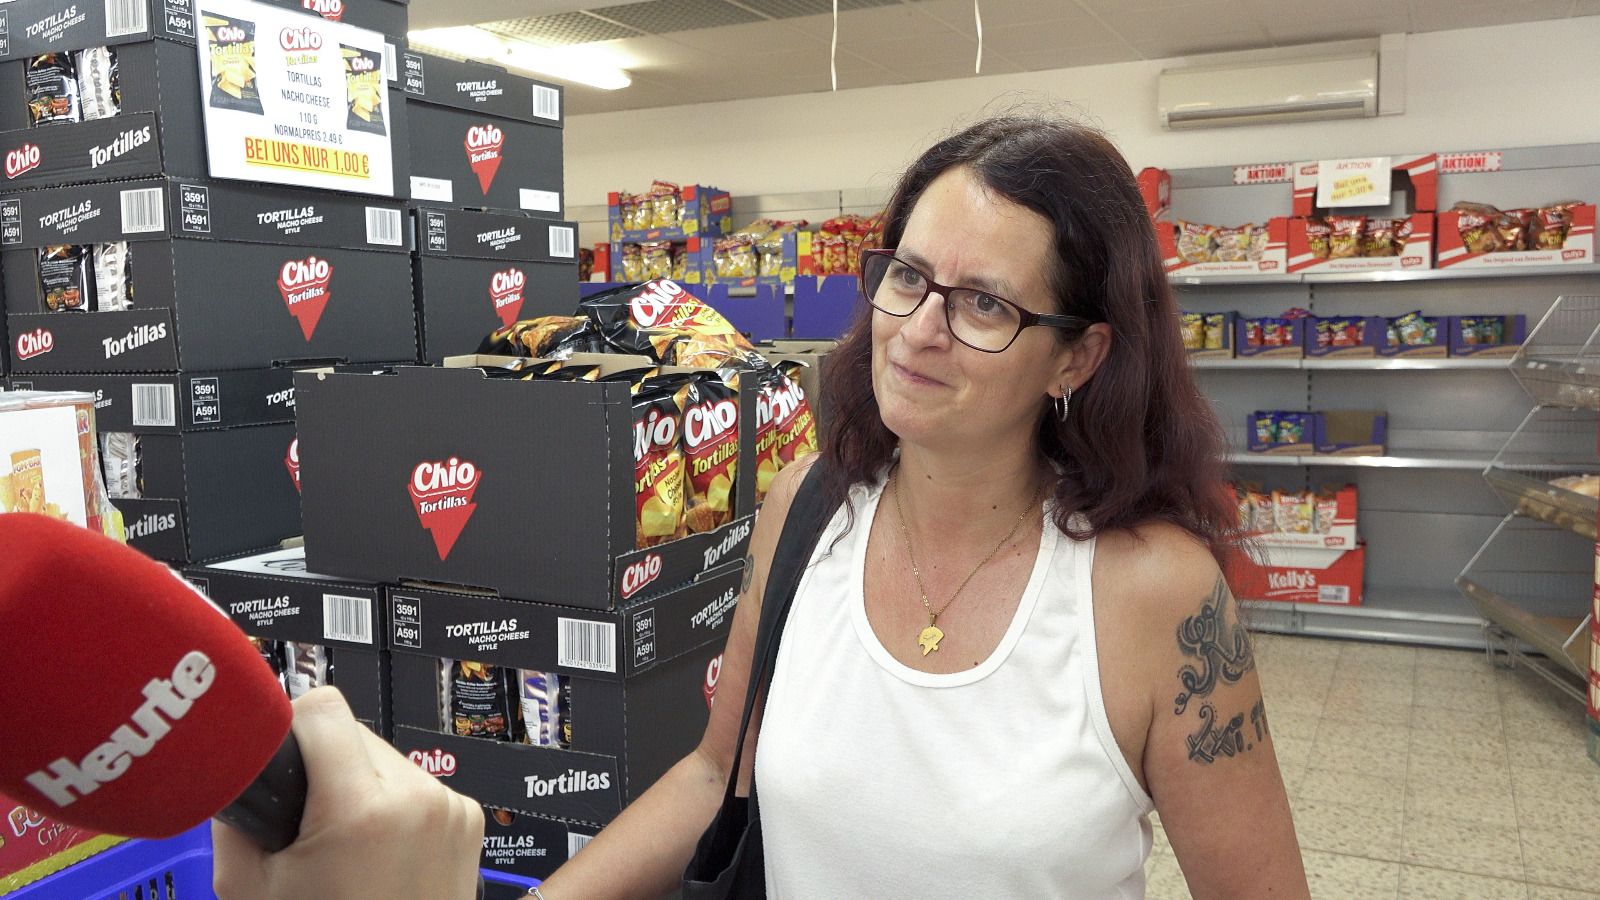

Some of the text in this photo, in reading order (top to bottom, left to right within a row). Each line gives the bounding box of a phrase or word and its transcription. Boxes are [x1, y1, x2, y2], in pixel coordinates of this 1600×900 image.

[26, 5, 77, 38] TORTILLAS
[42, 14, 86, 39] NACHO CHEESE
[169, 17, 192, 30] A591
[49, 32, 63, 43] STYLE
[218, 27, 245, 41] Chio
[280, 27, 322, 51] Chio
[406, 60, 421, 70] 3591
[287, 70, 322, 88] TORTILLAS
[407, 78, 422, 88] A591
[456, 80, 496, 92] TORTILLAS
[281, 89, 331, 109] NACHO CHEESE
[300, 112, 318, 125] 110 G
[274, 124, 322, 142] NORMALPREIS
[338, 134, 343, 144] €
[467, 124, 502, 148] Chio
[6, 125, 151, 174] Chio Tortillas
[245, 137, 370, 175] BEI UNS NUR 1,00 €
[471, 150, 498, 164] Tortillas
[1442, 157, 1487, 169] AKTION!
[1247, 167, 1286, 181] AKTION!
[184, 191, 205, 204] 3591
[2, 205, 18, 217] 3591
[39, 200, 92, 229] TORTILLAS
[56, 208, 101, 231] NACHO CHEESE
[257, 206, 314, 225] TORTILLAS
[185, 214, 207, 226] A591
[277, 215, 323, 230] NACHO CHEESE
[3, 227, 20, 238] A591
[63, 224, 78, 235] STYLE
[285, 227, 300, 235] STYLE
[477, 227, 515, 243] TORTILLAS
[282, 256, 328, 287] Chio
[492, 268, 524, 293] Chio
[287, 285, 325, 305] Tortillas
[495, 292, 520, 309] Tortillas
[632, 279, 682, 327] Chio
[17, 322, 167, 359] Chio Tortillas
[194, 384, 215, 395] 3591
[195, 405, 217, 417] A591
[685, 400, 737, 448] Chio
[776, 411, 812, 450] Tortillas
[692, 440, 738, 477] Tortillas
[414, 457, 475, 492] Chio
[420, 496, 467, 515] Tortillas
[124, 513, 175, 542] ortillas
[622, 521, 750, 593] Chio Tortillas
[1268, 570, 1316, 589] Kelly's
[230, 596, 290, 616] TORTILLAS
[249, 607, 300, 620] NACHO CHEESE
[396, 604, 417, 617] 3591
[691, 587, 734, 629] TORTILLAS
[256, 618, 274, 627] STYLE
[636, 617, 652, 632] 3591
[705, 610, 723, 627] NACHO
[396, 627, 418, 640] A591
[446, 618, 517, 638] TORTILLAS
[468, 631, 530, 645] NACHO CHEESE
[478, 643, 498, 651] STYLE
[636, 641, 654, 658] A591
[25, 651, 217, 807] Heute
[524, 769, 611, 798] Tortillas
[483, 835, 535, 849] RTILLAS
[485, 848, 547, 857] NACHO CHEESE
